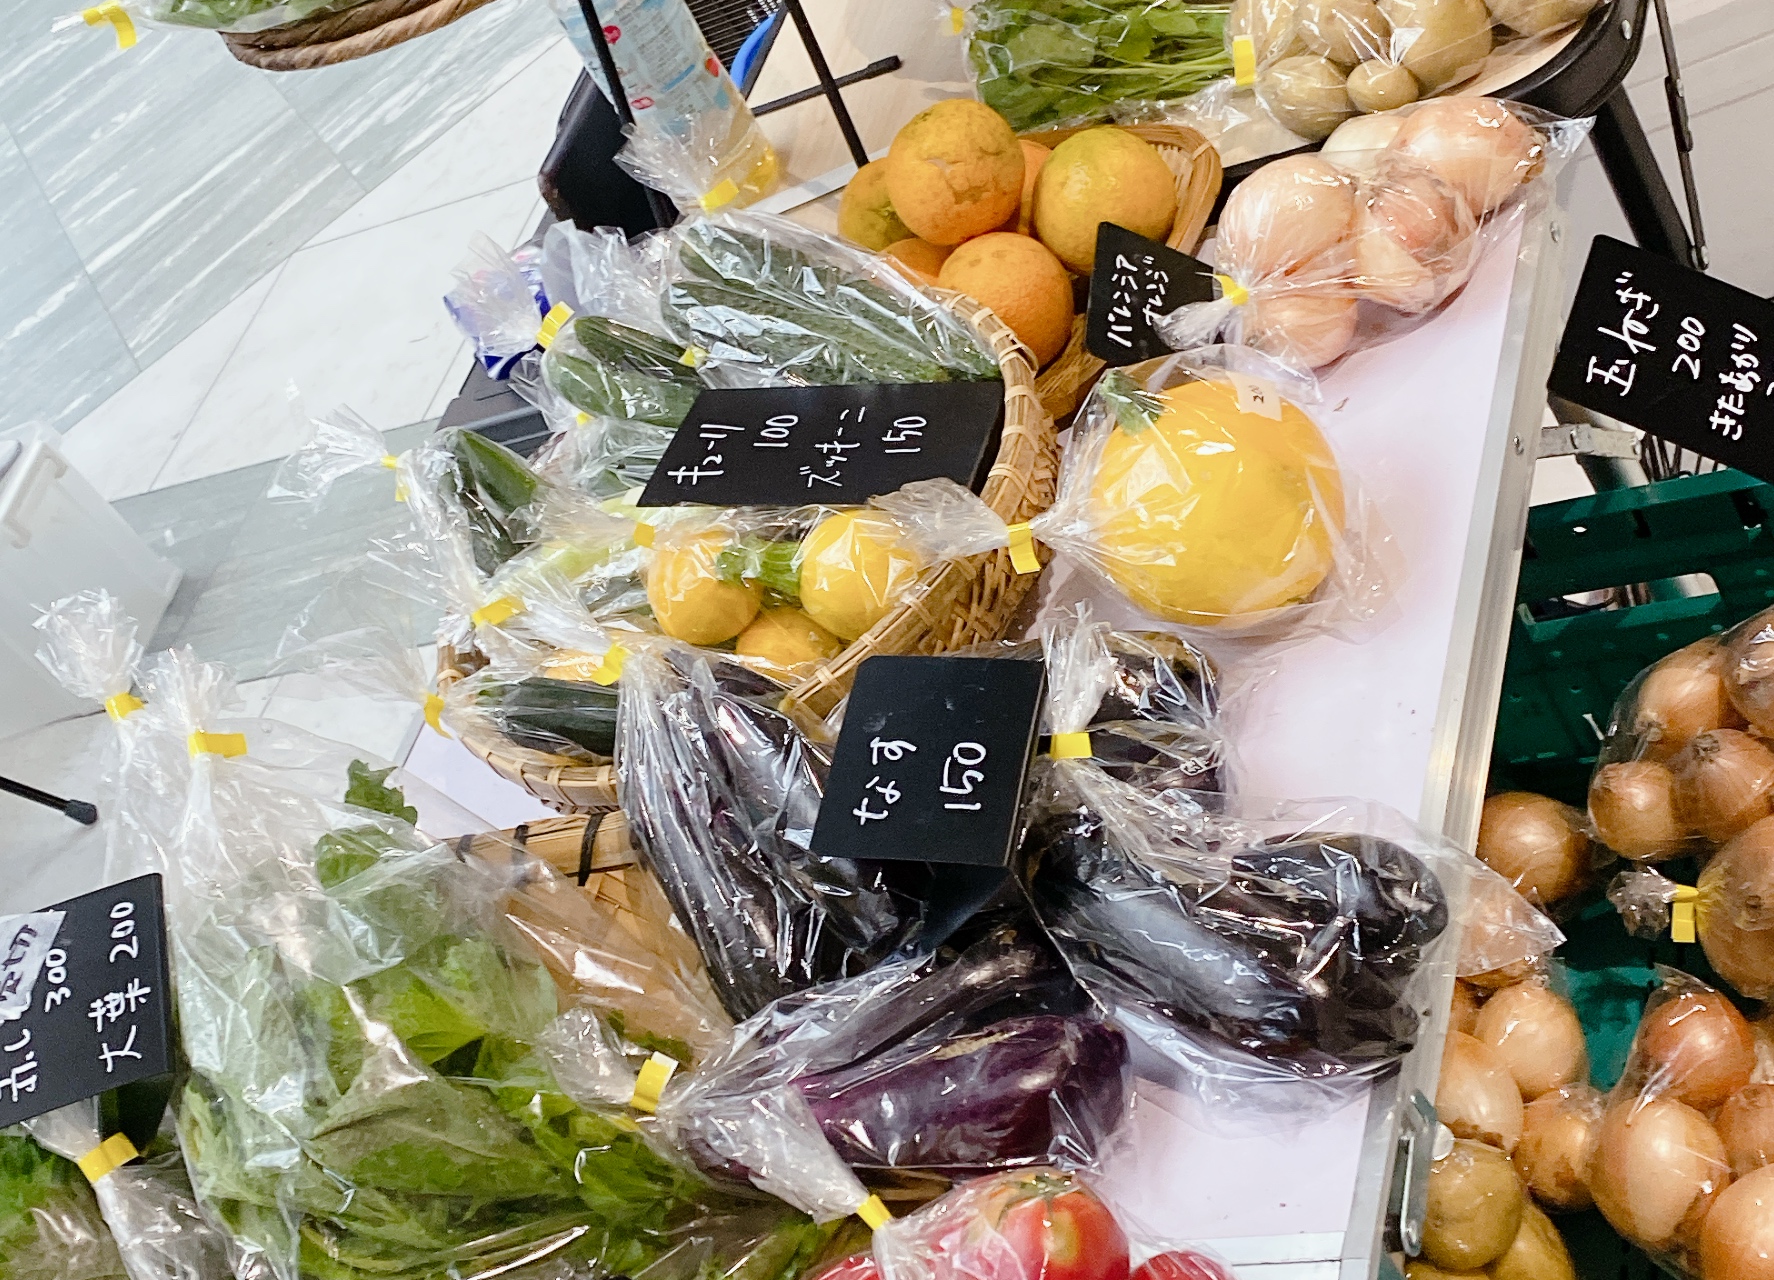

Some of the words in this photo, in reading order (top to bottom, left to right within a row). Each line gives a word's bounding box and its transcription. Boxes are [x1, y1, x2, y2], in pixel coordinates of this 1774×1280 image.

[1107, 254, 1138, 348] バレンシア
[1585, 271, 1660, 397] 玉ねぎ
[1671, 316, 1706, 380] 200
[1709, 322, 1761, 441] きたあかり
[667, 422, 745, 486] キューリ
[753, 414, 799, 448] 100
[799, 406, 867, 488] ズッキーニ
[882, 415, 927, 454] 150
[852, 736, 918, 826] なす
[939, 742, 987, 811] 150
[109, 901, 139, 963] 200
[44, 948, 71, 1013] 300
[88, 978, 151, 1073] 大葉
